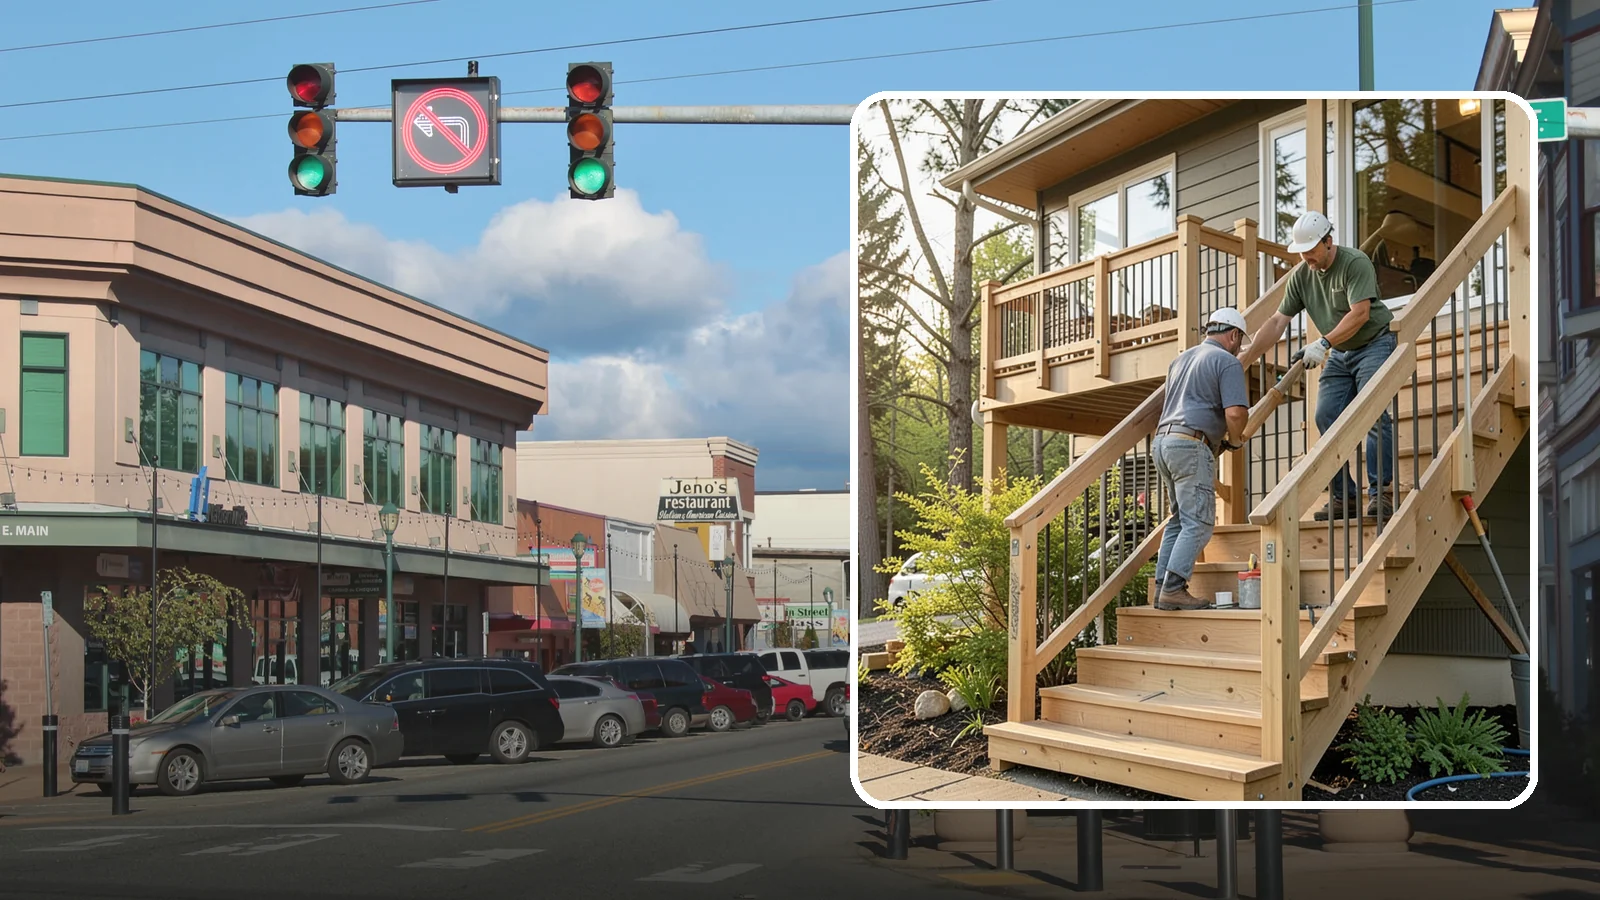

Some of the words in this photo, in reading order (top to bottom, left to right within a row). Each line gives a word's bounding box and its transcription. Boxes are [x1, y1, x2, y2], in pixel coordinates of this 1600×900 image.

[669, 480, 727, 494] Jeno's
[665, 496, 731, 509] restaurant
[658, 510, 681, 519] Italian
[686, 510, 714, 519] American
[715, 509, 738, 519] Cuisine
[2, 525, 13, 536] E.
[15, 525, 49, 536] MAIN
[797, 607, 828, 617] Street
